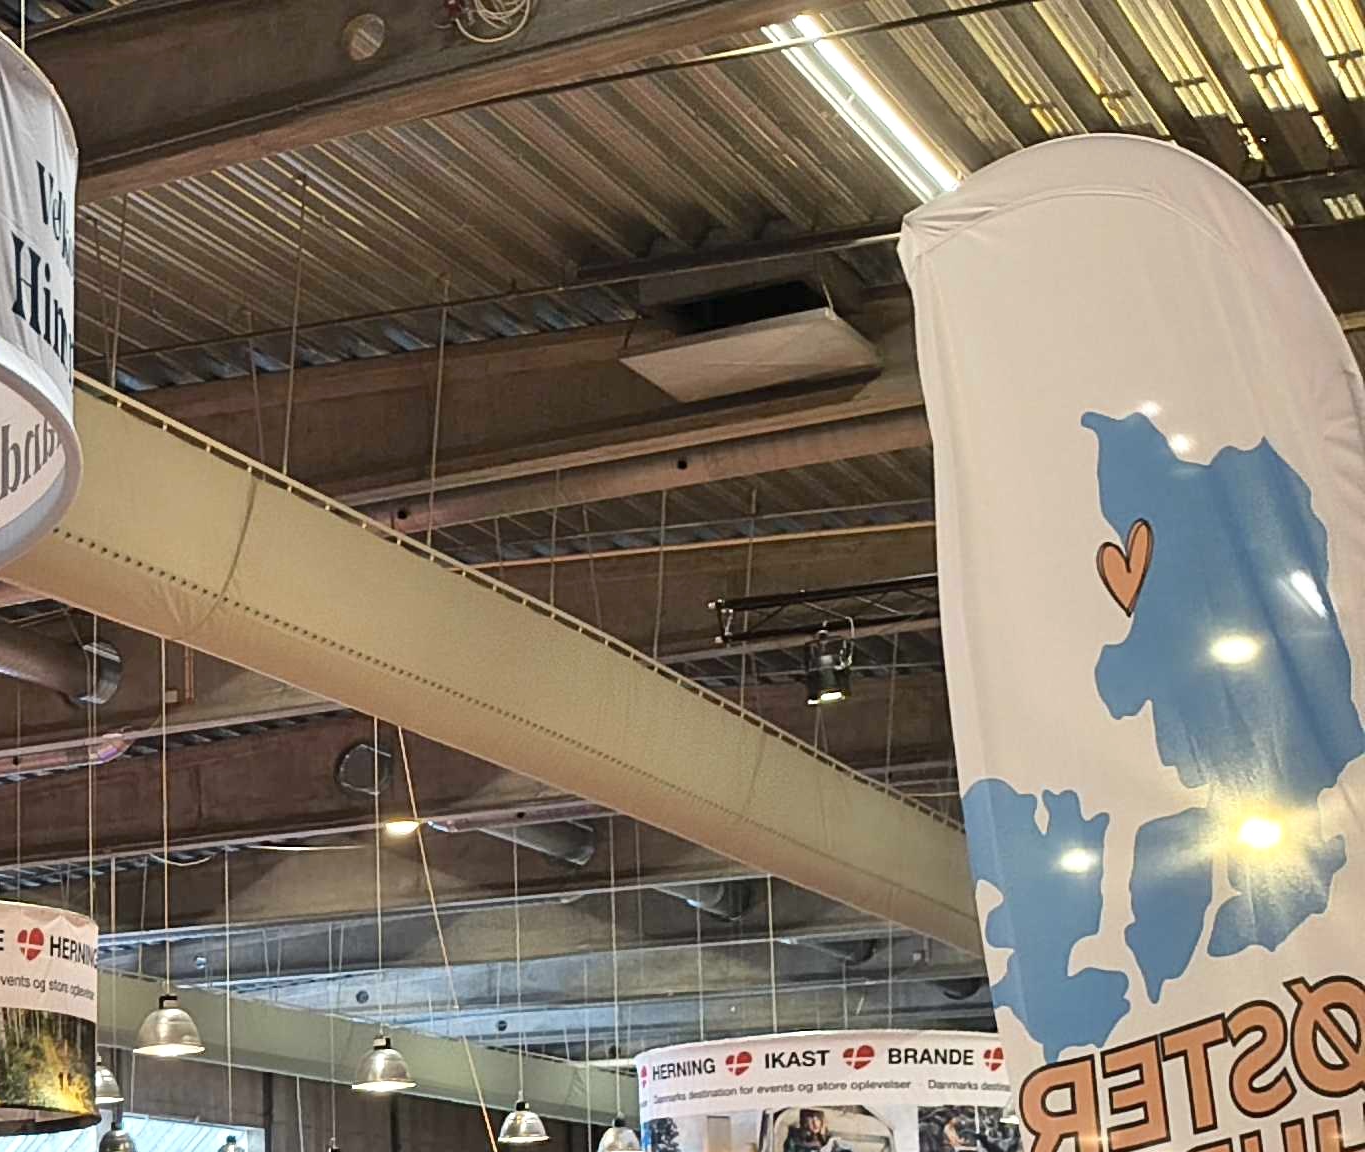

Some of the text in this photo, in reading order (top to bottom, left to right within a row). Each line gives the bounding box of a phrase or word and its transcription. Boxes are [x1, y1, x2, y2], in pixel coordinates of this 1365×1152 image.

[33, 978, 46, 993] og
[652, 1048, 974, 1080] HERNING IKAST BRANDE
